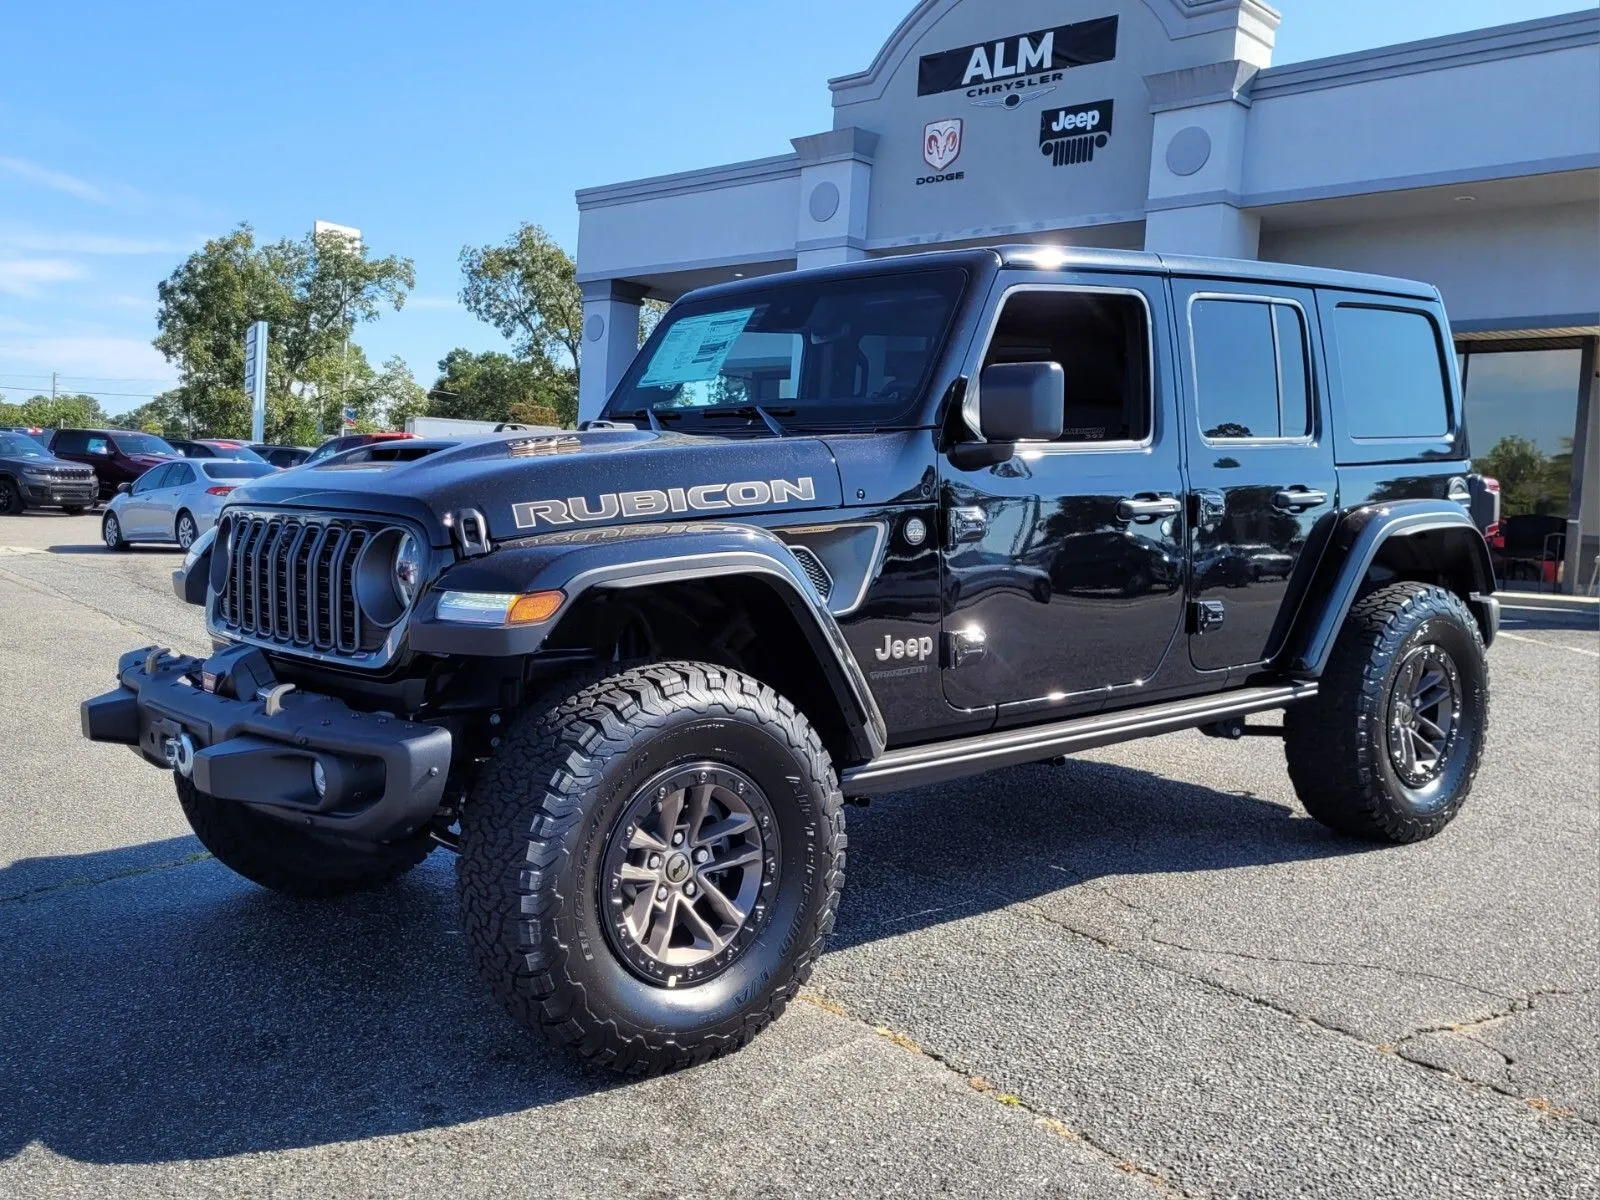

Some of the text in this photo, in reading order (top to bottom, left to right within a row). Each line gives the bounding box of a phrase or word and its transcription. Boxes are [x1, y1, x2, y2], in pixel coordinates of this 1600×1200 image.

[961, 32, 1055, 86] ALM
[966, 72, 1064, 98] CHRYSLER
[1051, 109, 1100, 132] Jeep
[915, 171, 965, 186] DODGE
[511, 477, 816, 529] RUBICON
[874, 634, 933, 661] Jeep
